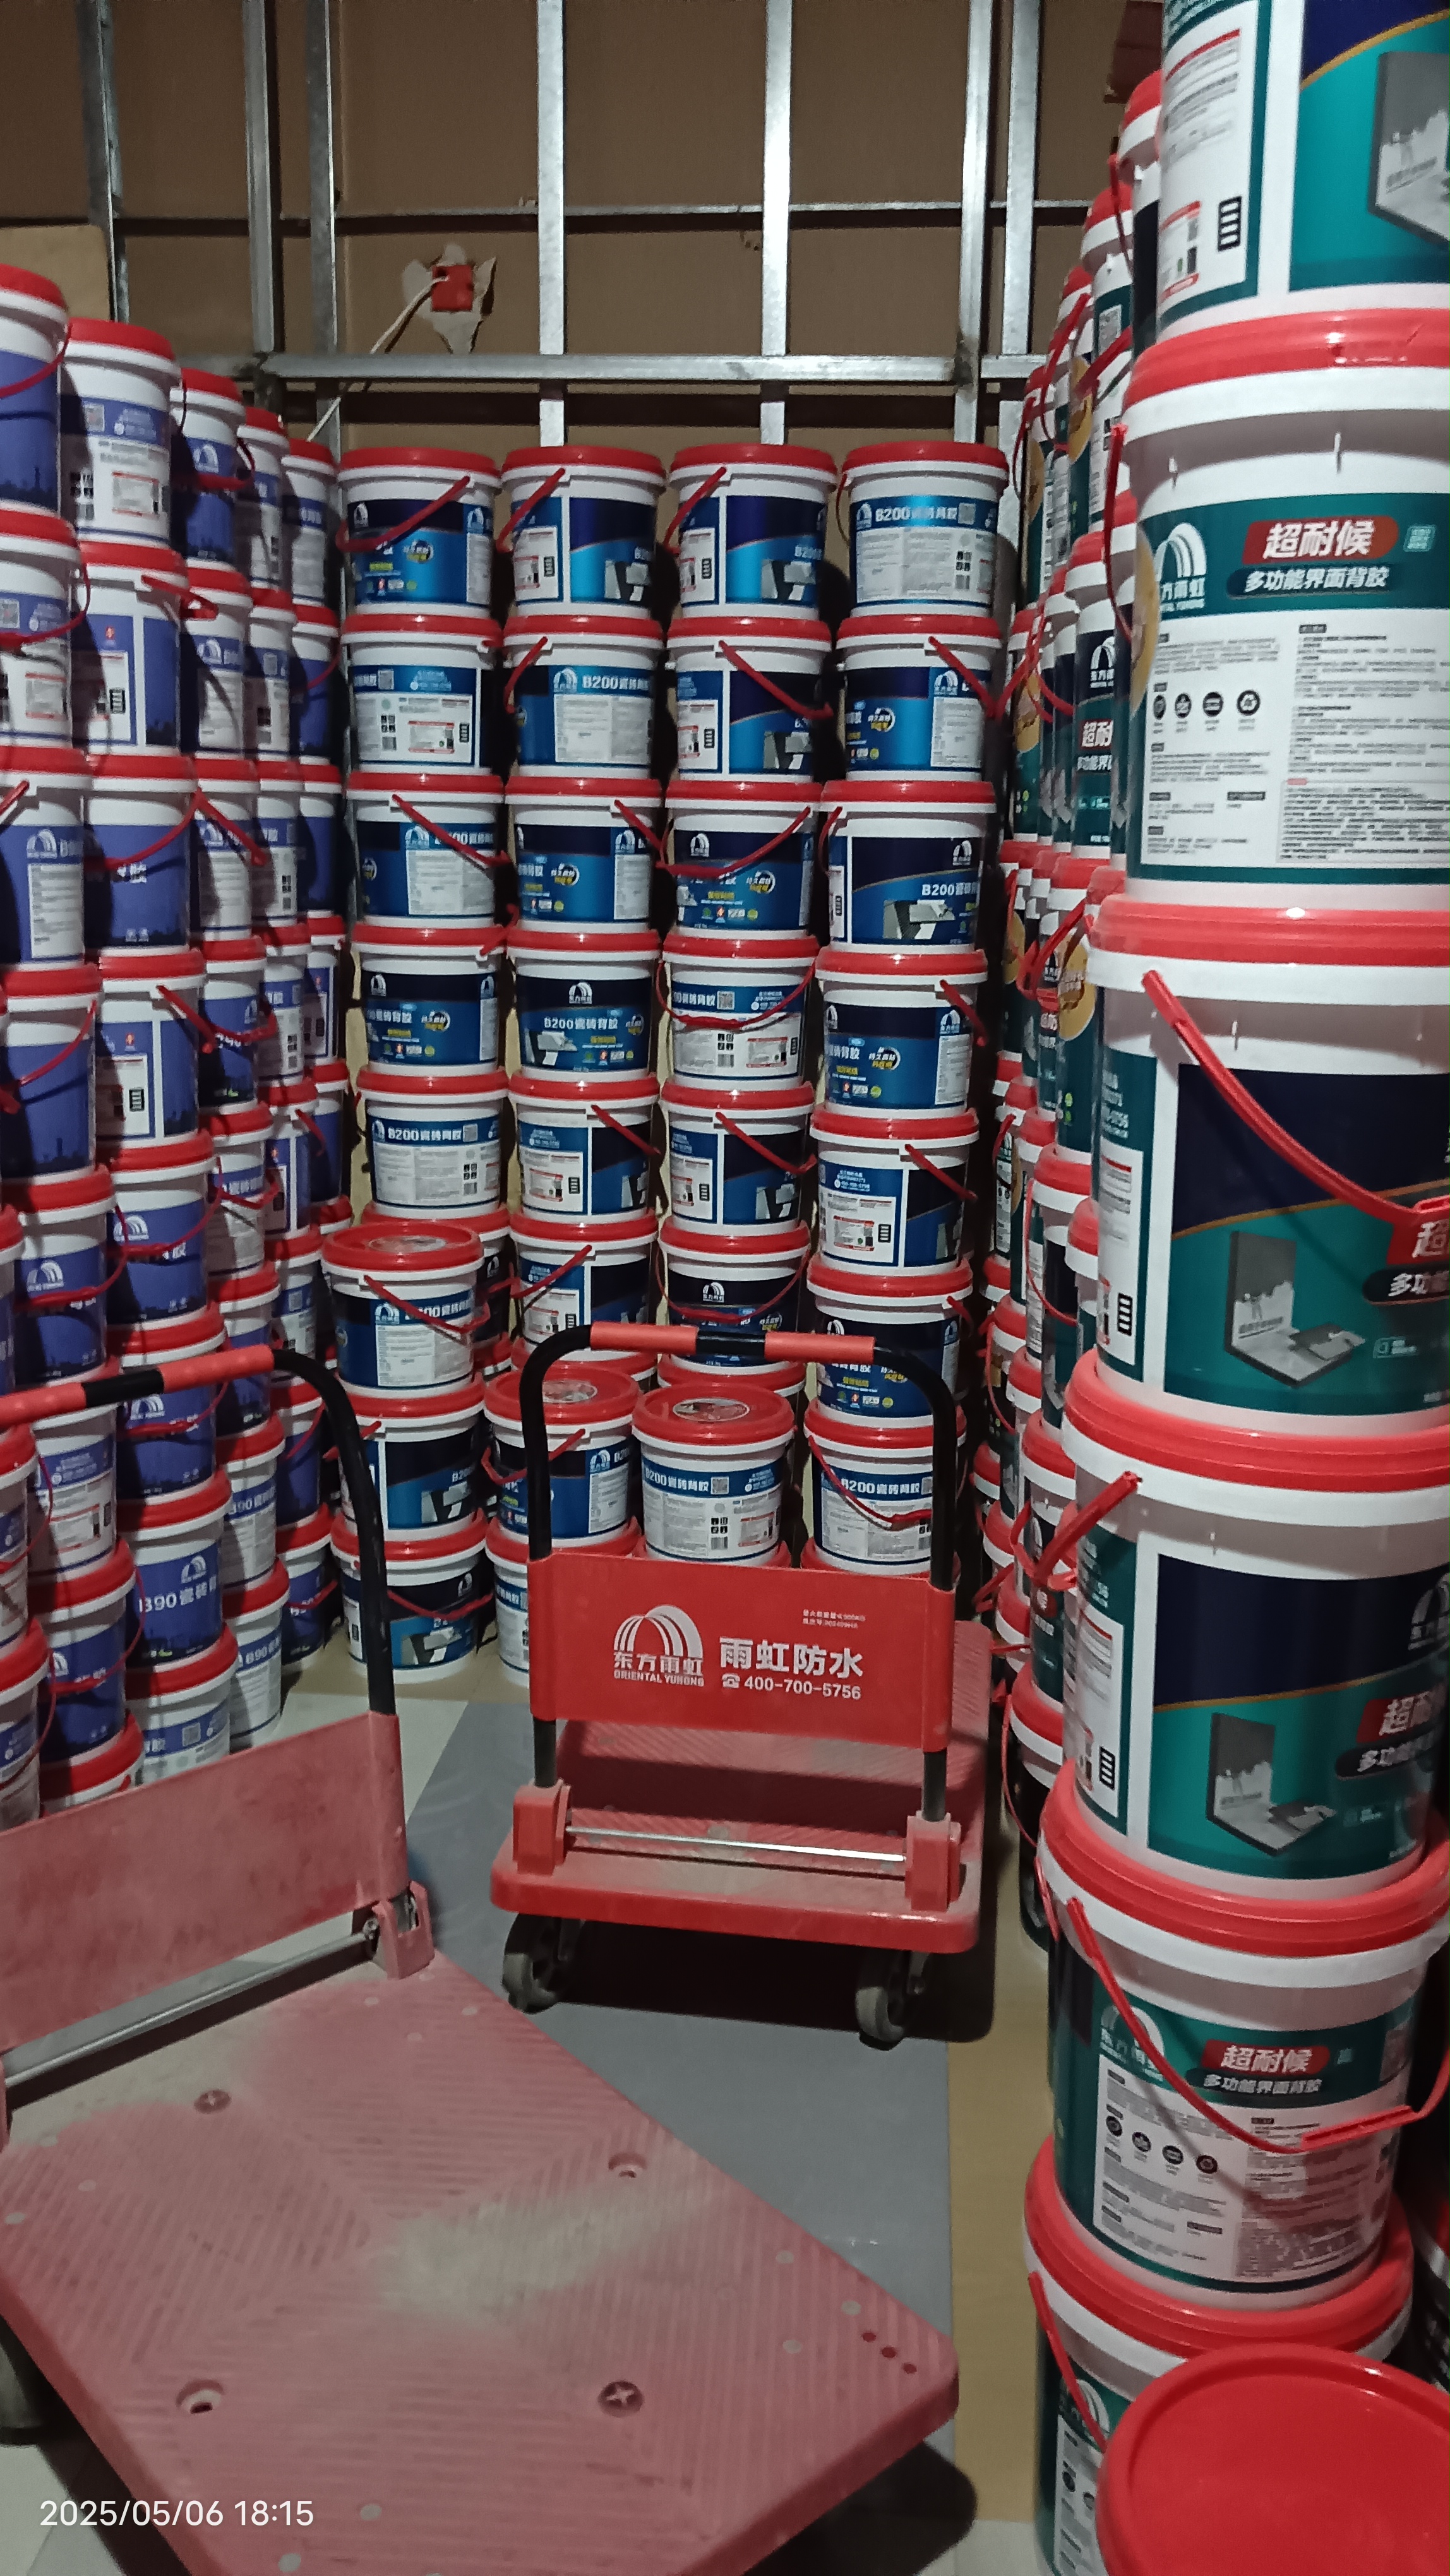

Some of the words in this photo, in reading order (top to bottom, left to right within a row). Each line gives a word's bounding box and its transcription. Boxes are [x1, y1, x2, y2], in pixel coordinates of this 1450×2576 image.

[1262, 519, 1374, 559] 超耐候
[1244, 566, 1389, 592] 多功能界面背胶
[613, 1651, 703, 1677] 东方雨虹
[719, 1636, 863, 1679] 雨虹防水
[743, 1675, 861, 1700] 400-700-5756
[1220, 2044, 1313, 2073] 超耐候
